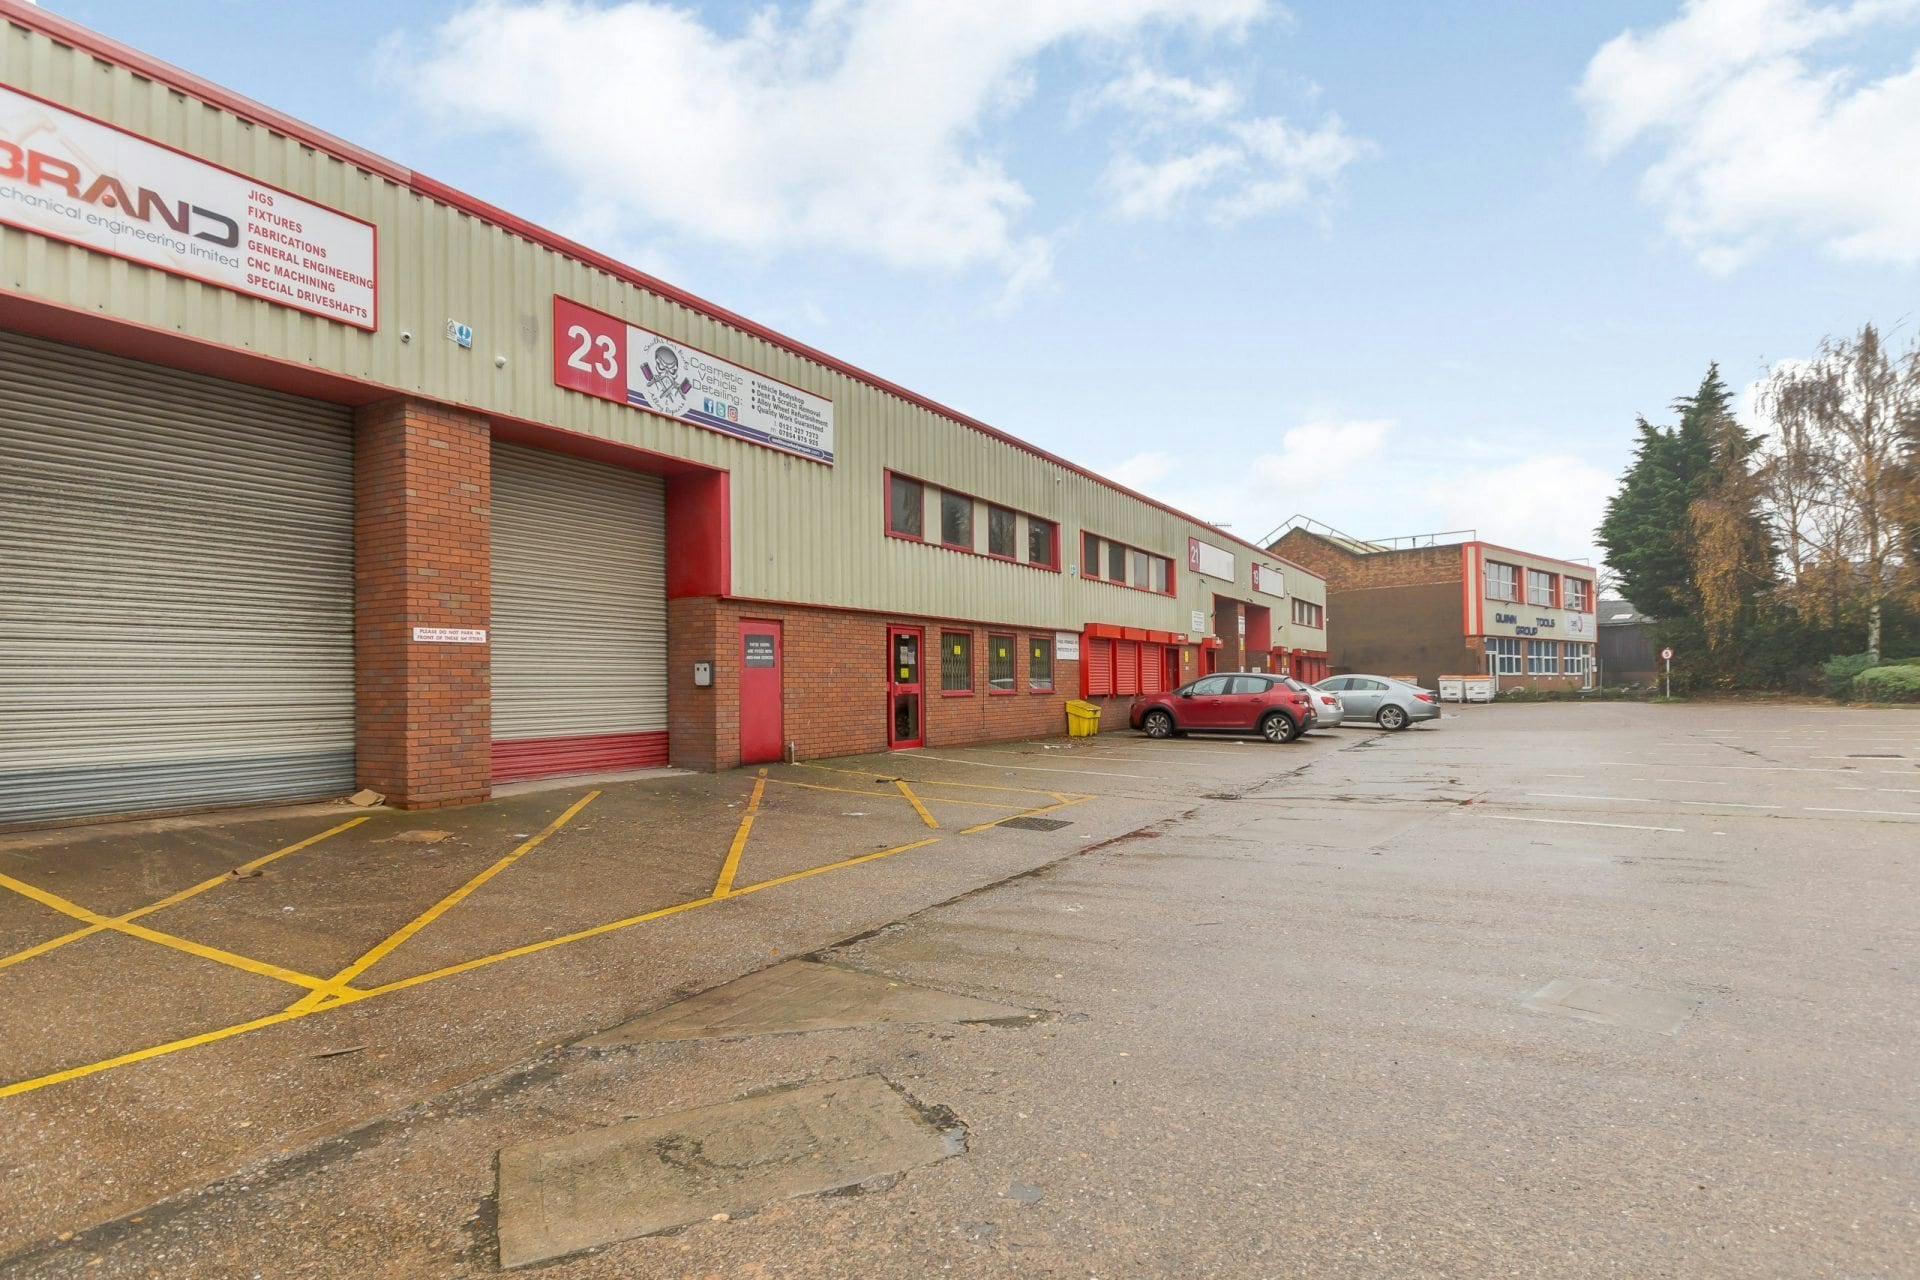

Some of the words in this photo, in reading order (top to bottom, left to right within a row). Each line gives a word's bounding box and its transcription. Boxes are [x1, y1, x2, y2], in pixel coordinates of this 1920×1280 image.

[248, 190, 274, 207] JIGS
[247, 205, 303, 234] FIXTURES
[86, 211, 186, 254] engineering
[190, 243, 239, 269] limited
[247, 222, 327, 259] FABRICATIONS
[247, 239, 300, 266] GENERAL
[303, 257, 374, 290] ENGINEERING
[247, 256, 271, 273] CNC
[274, 265, 336, 293] MACHINING
[246, 273, 294, 297] SPECIAL
[297, 288, 368, 319] DRIVESHAFTS
[567, 325, 619, 379] 23
[690, 356, 744, 386] Cosmetic
[697, 369, 738, 393] Vehicle
[756, 390, 771, 401] Dent
[777, 397, 798, 410] Scratch
[799, 404, 821, 418] Removal
[757, 382, 778, 395] Vehicle
[779, 390, 805, 405] Bodyshop
[757, 398, 772, 410] Alloy
[772, 403, 790, 414] Wheel
[757, 405, 778, 418] Quality
[779, 412, 793, 423] Work
[1191, 546, 1199, 565] 21
[1495, 613, 1517, 625] QUINN
[1536, 617, 1555, 628] TOOLS
[1516, 626, 1538, 636] GROUP
